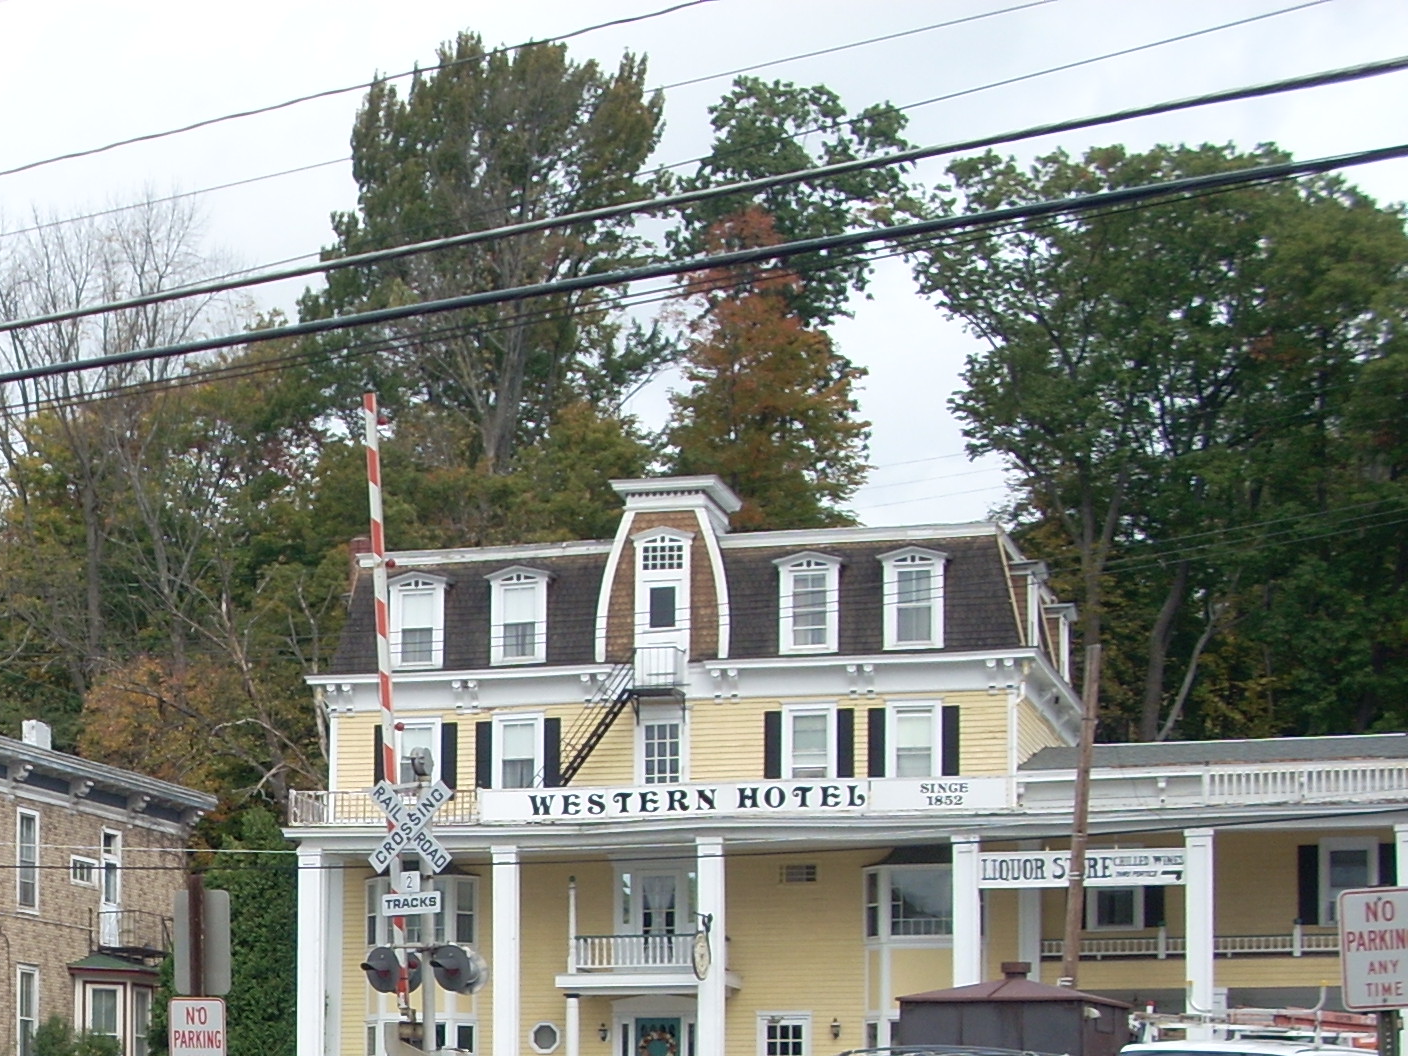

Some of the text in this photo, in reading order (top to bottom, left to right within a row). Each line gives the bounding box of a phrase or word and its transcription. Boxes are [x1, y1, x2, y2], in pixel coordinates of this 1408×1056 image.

[528, 785, 867, 816] WESTERN HOTEL
[926, 795, 963, 806] 1852
[374, 788, 445, 865] CROSSING
[981, 858, 1047, 881] LIQUOR
[385, 896, 437, 910] TRACKS
[1365, 900, 1395, 922] NO
[1346, 928, 1408, 952] PARKIN
[1368, 960, 1399, 975] ANY
[1365, 982, 1404, 997] TIME
[186, 1006, 208, 1025] NO
[174, 1030, 222, 1048] PARKING
